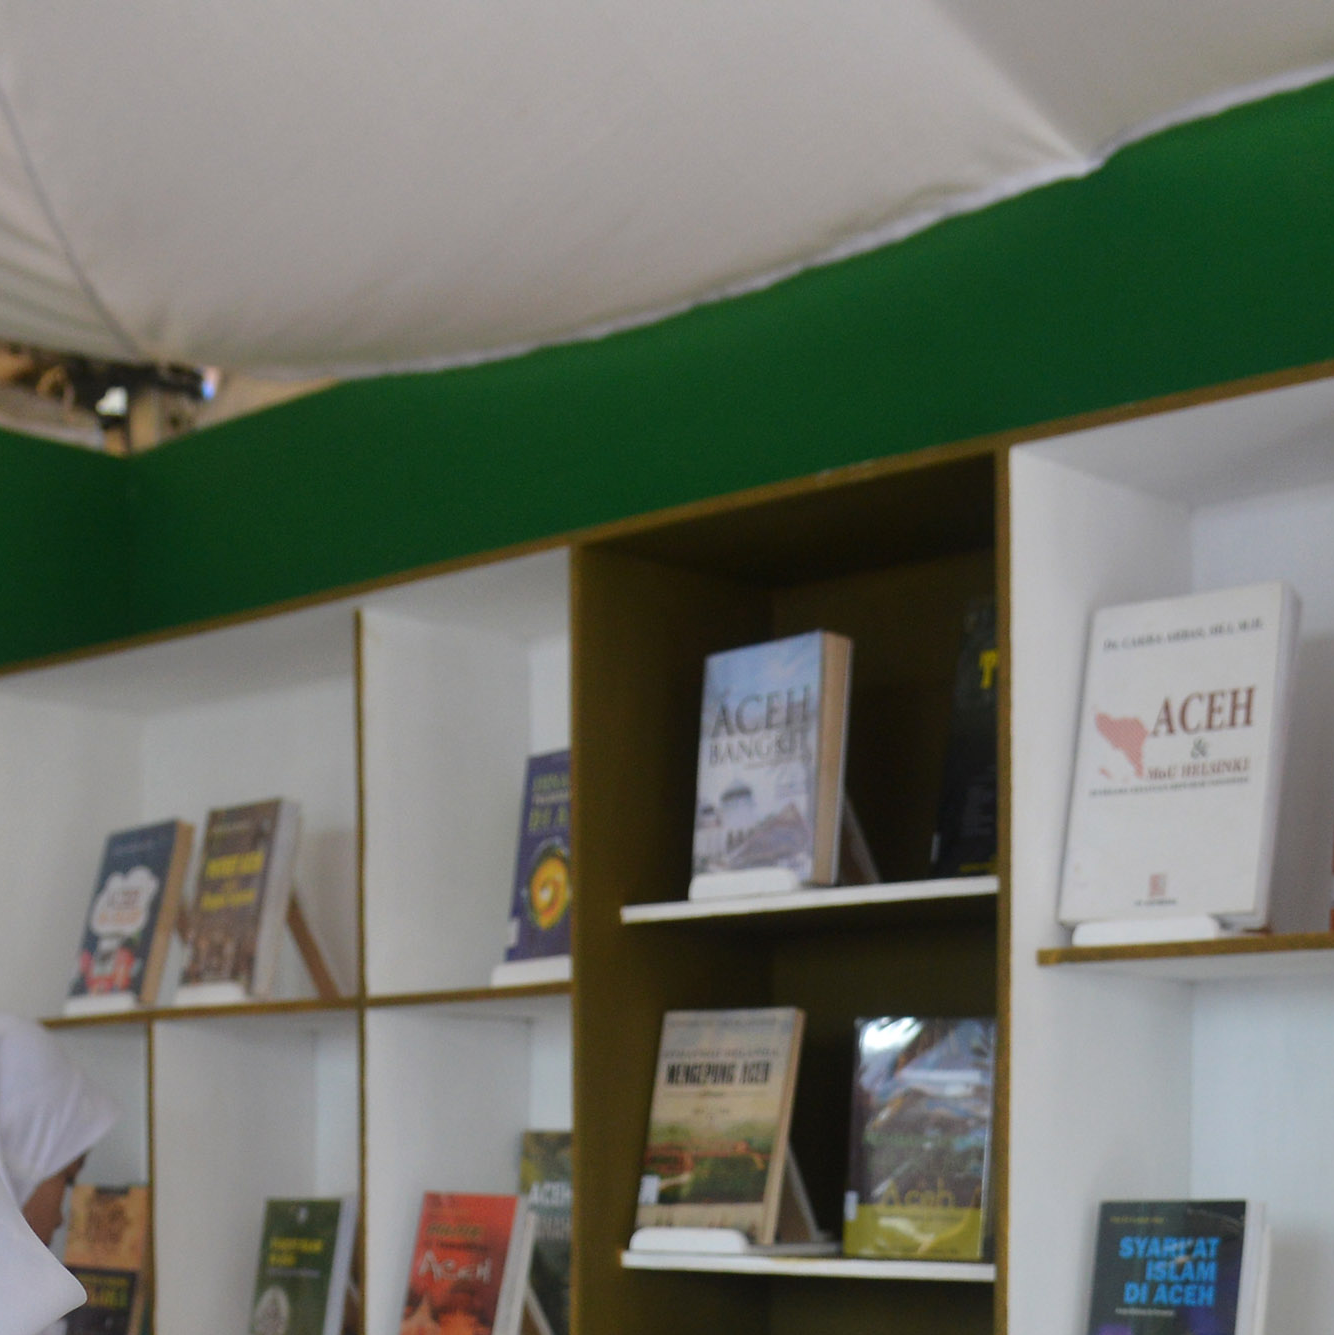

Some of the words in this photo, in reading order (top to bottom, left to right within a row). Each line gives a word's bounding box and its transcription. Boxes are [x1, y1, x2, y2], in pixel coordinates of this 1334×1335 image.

[711, 685, 814, 738] ACEH
[1151, 686, 1256, 737] ACEH
[1190, 737, 1208, 760] &
[1181, 757, 1251, 778] HELSINKI
[1145, 1260, 1218, 1282] ISLAM
[1124, 1281, 1147, 1305] DI
[1152, 1282, 1215, 1306] ACEH
